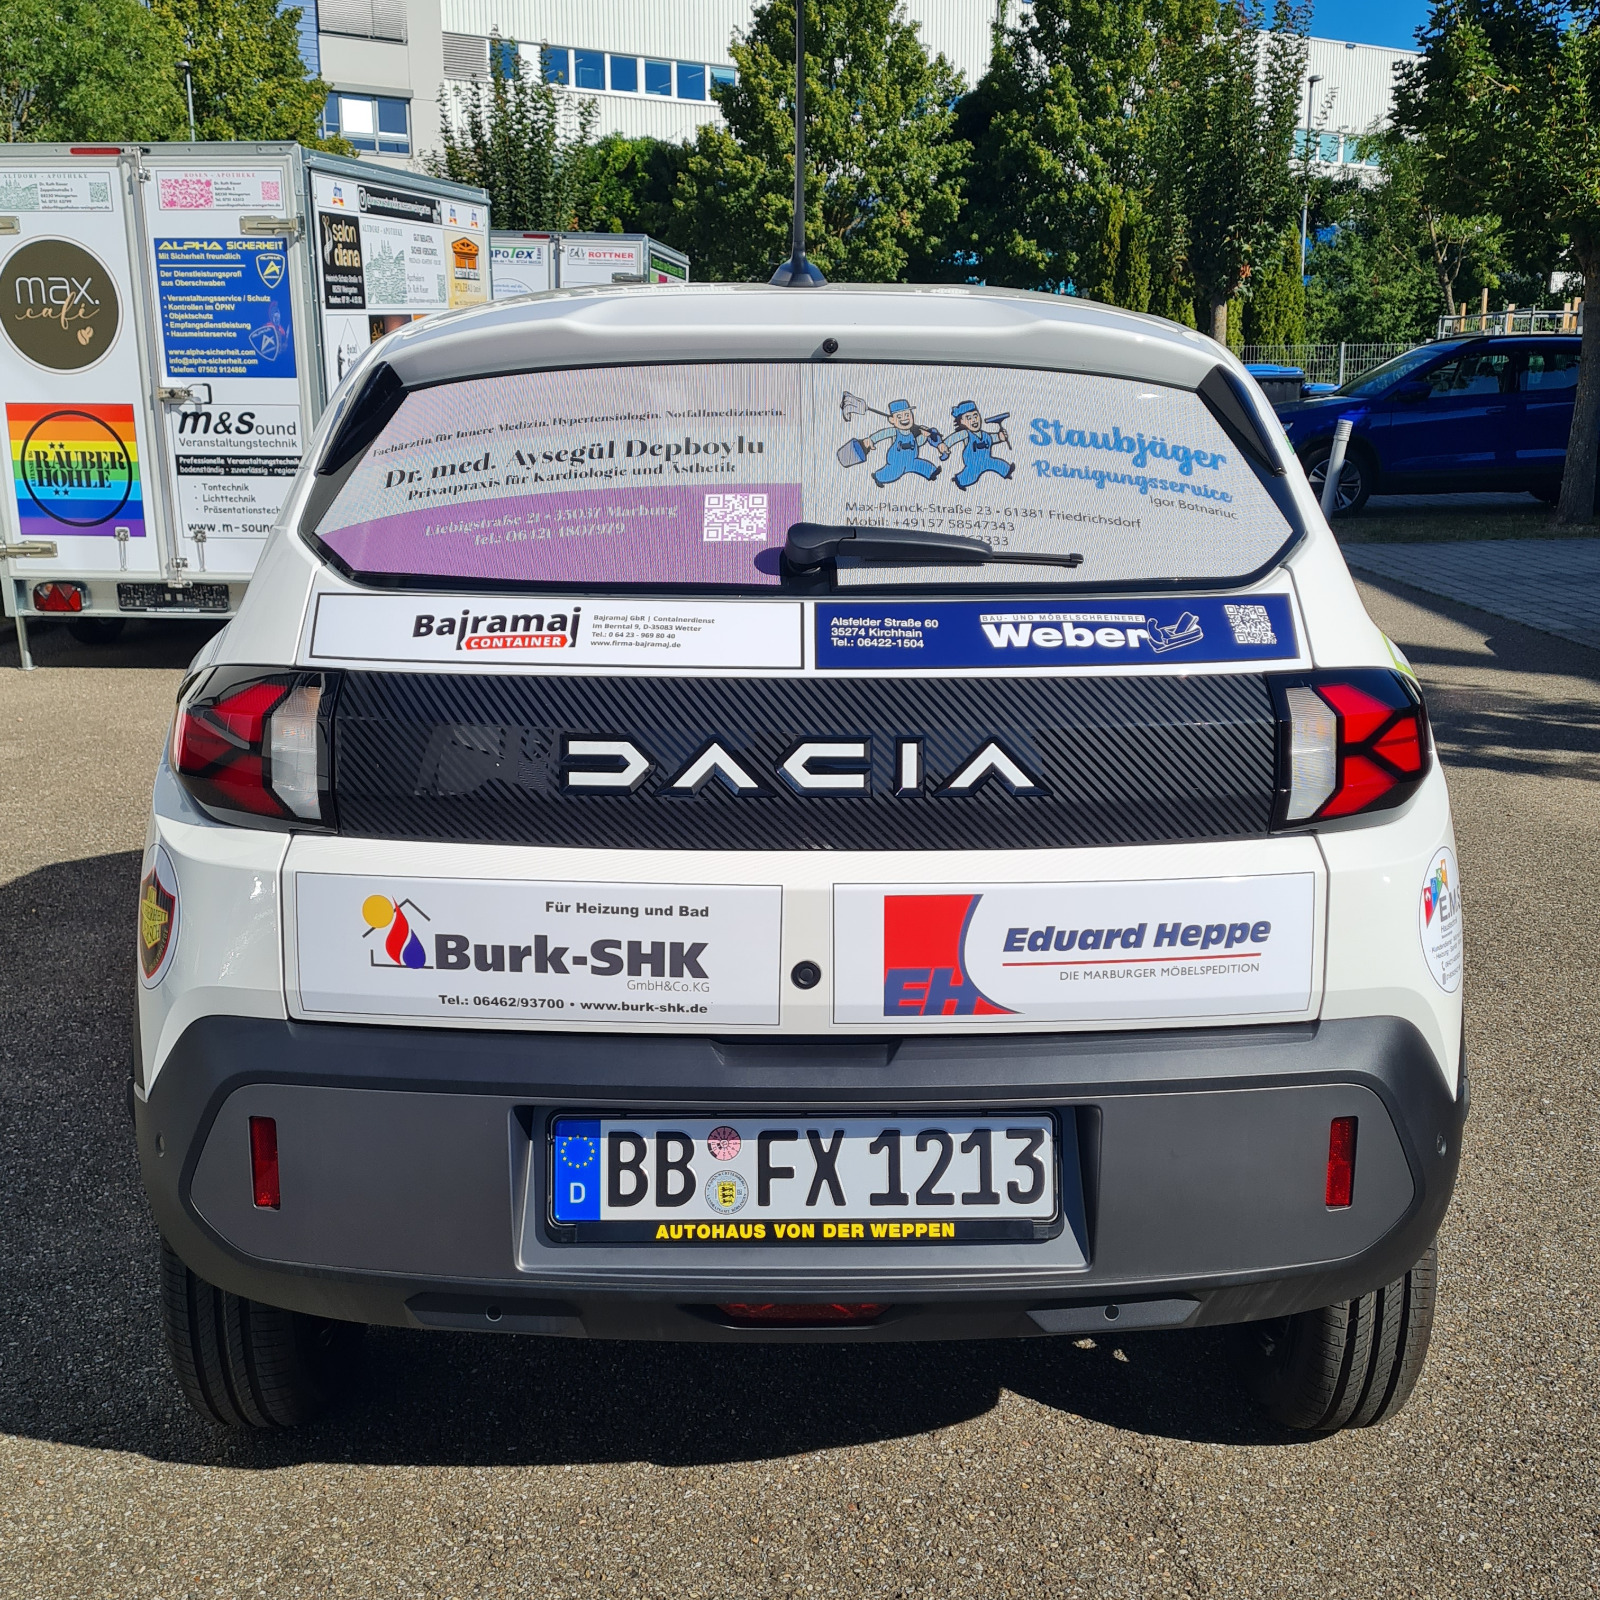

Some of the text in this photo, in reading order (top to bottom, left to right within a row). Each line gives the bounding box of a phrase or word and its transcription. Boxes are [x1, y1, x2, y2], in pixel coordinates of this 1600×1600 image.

[332, 222, 357, 243] salon
[158, 241, 284, 250] ALPHA SICHERHEIT
[333, 242, 360, 267] diana
[490, 248, 534, 259] POTex
[174, 270, 242, 279] Dienstleistungsprofi
[170, 322, 251, 330] Empfangsdienstleistung
[179, 438, 297, 449] Veranstaltungstechnik
[435, 432, 453, 443] für
[456, 426, 495, 438] Innere
[1029, 417, 1227, 476] Staubjäger
[180, 466, 224, 474] bodenständig
[231, 467, 268, 475] zuverlässig
[227, 458, 300, 466] Veranstaltungstechnik
[384, 436, 764, 489] Dr. med. Aysegül Depboylu
[202, 483, 249, 491] Tontechnik
[408, 476, 500, 500] Privatpraxis
[505, 474, 529, 486] für
[534, 467, 627, 482] Kardiologie
[632, 464, 663, 476] und
[1031, 459, 1233, 503] Reinigungsservice
[204, 505, 280, 514] Präsentationstech
[845, 502, 1141, 528] Max-Planck-Straße 23 61381 Friedrichsdorf
[1150, 495, 1237, 519] Igor Botnariuc
[846, 517, 1015, 531] Mobil: +49157 58547343
[412, 606, 582, 650] Bajramaj
[831, 617, 939, 628] Alsfelder Straße 60
[831, 628, 922, 637] 35274 Kirchhain
[982, 622, 1149, 648] Weber
[470, 637, 561, 648] CONTAINER
[591, 640, 681, 648] www.firma-bajramaj.de
[831, 638, 924, 648] Tel.: 06422-1504
[566, 738, 1044, 794] DACIA
[545, 901, 709, 918] Für Heizung und Bad
[1003, 920, 1272, 953] Eduard Heppe
[434, 933, 710, 979] Burk-SHK
[1059, 962, 1260, 981] DIE MARBURGER MÖBELSPEDITION
[626, 980, 710, 993] GmbH&Co.KG
[884, 967, 979, 1016] EH
[438, 995, 708, 1014] Tel.: 06462/93700 www.burk-shk.de
[606, 1129, 697, 1208] BB
[757, 1129, 846, 1207] FX
[869, 1128, 1046, 1206] 1213
[569, 1182, 586, 1204] D
[655, 1222, 956, 1240] AUTOHAUS VON DER WEPPEN
